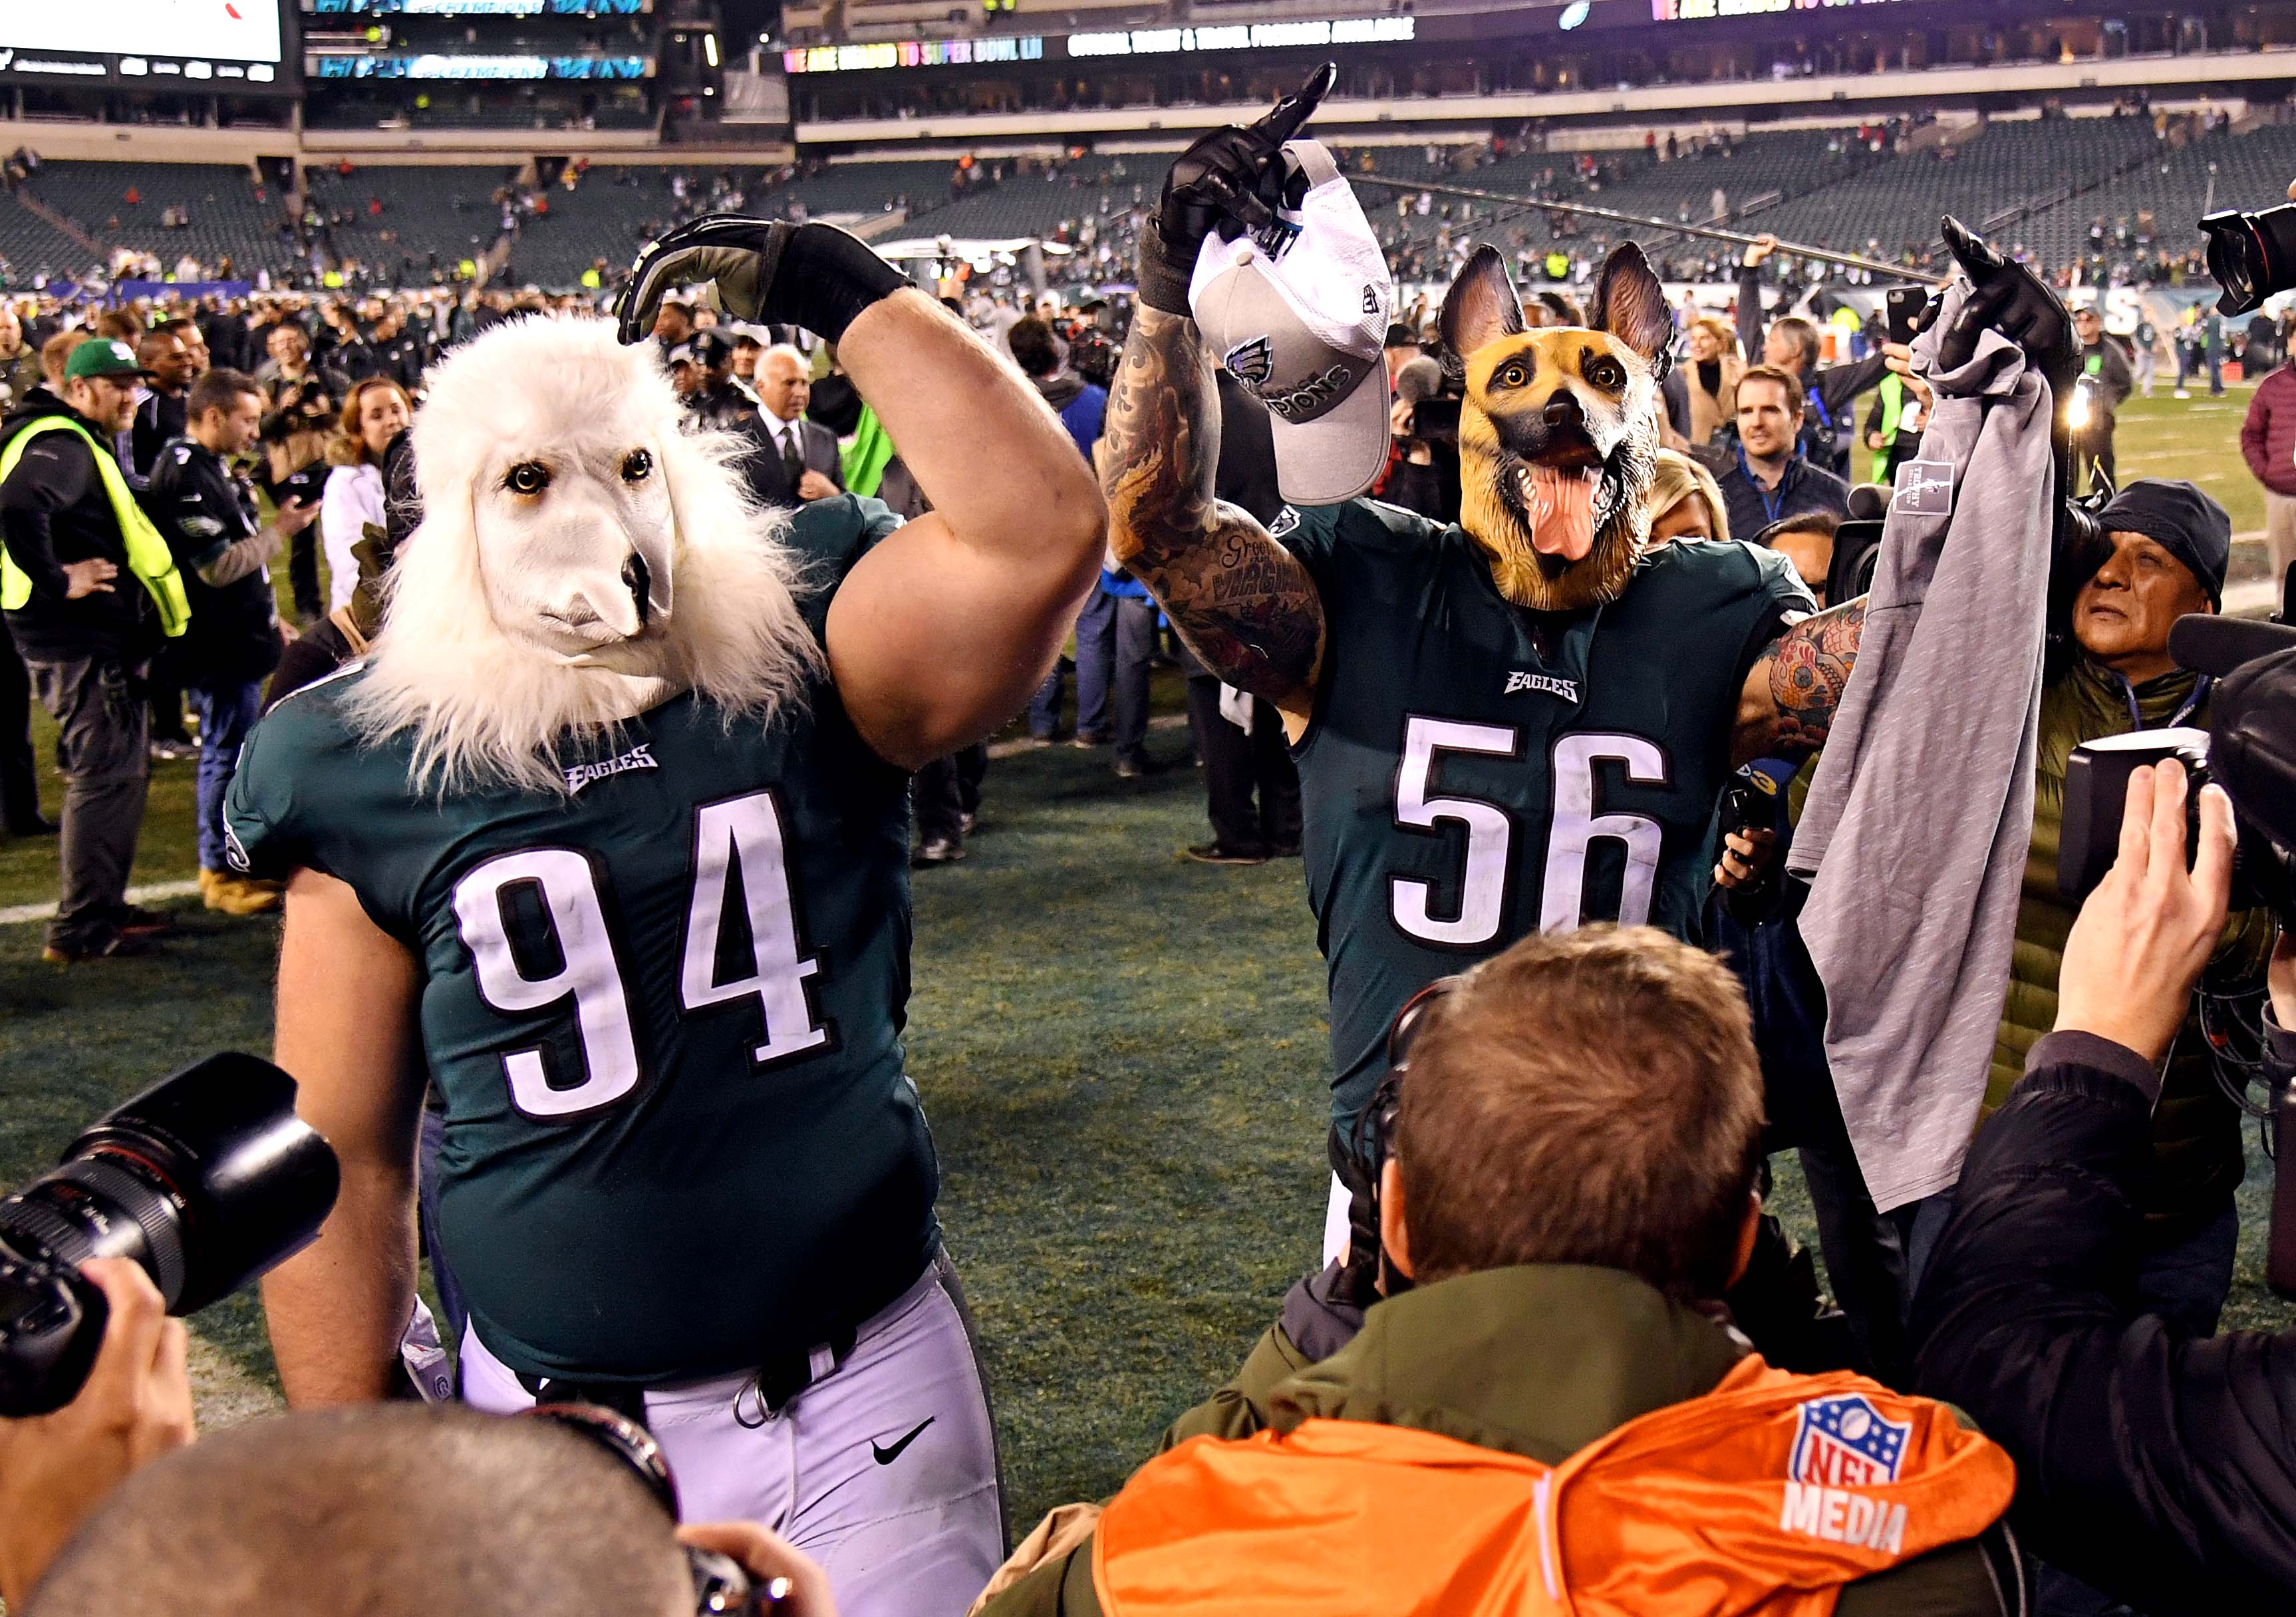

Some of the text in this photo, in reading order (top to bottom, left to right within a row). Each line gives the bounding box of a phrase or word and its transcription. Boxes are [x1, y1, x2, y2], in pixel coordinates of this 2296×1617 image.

[1503, 670, 1578, 704] EAGLES
[563, 742, 658, 796] EAGLES
[1393, 717, 1664, 944] 56
[452, 791, 827, 1117] 94
[1779, 1480, 1908, 1555] MEDIA
